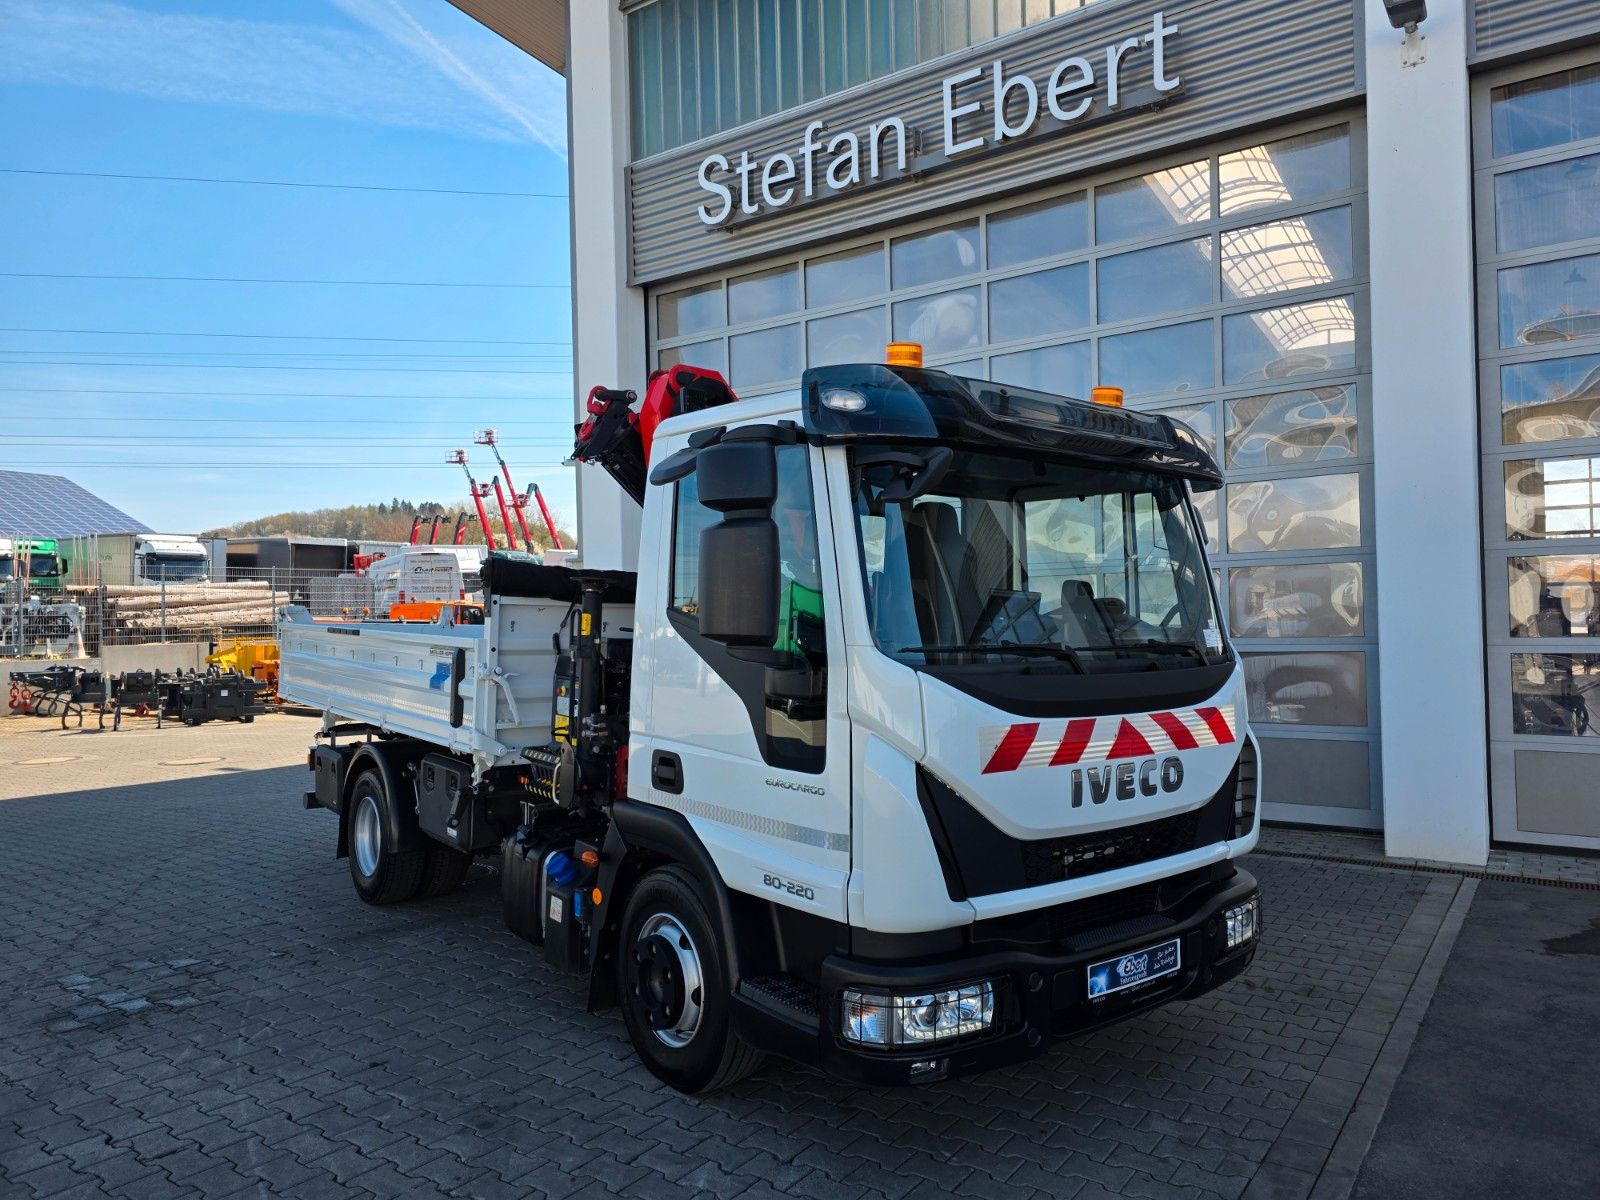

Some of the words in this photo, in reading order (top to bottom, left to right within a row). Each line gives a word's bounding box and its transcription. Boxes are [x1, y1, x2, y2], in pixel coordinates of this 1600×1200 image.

[697, 115, 906, 226] Stefan
[942, 11, 1181, 157] Ebert
[765, 778, 825, 796] EUROCARGO
[1071, 755, 1184, 808] IVECO
[763, 873, 815, 901] 80-220
